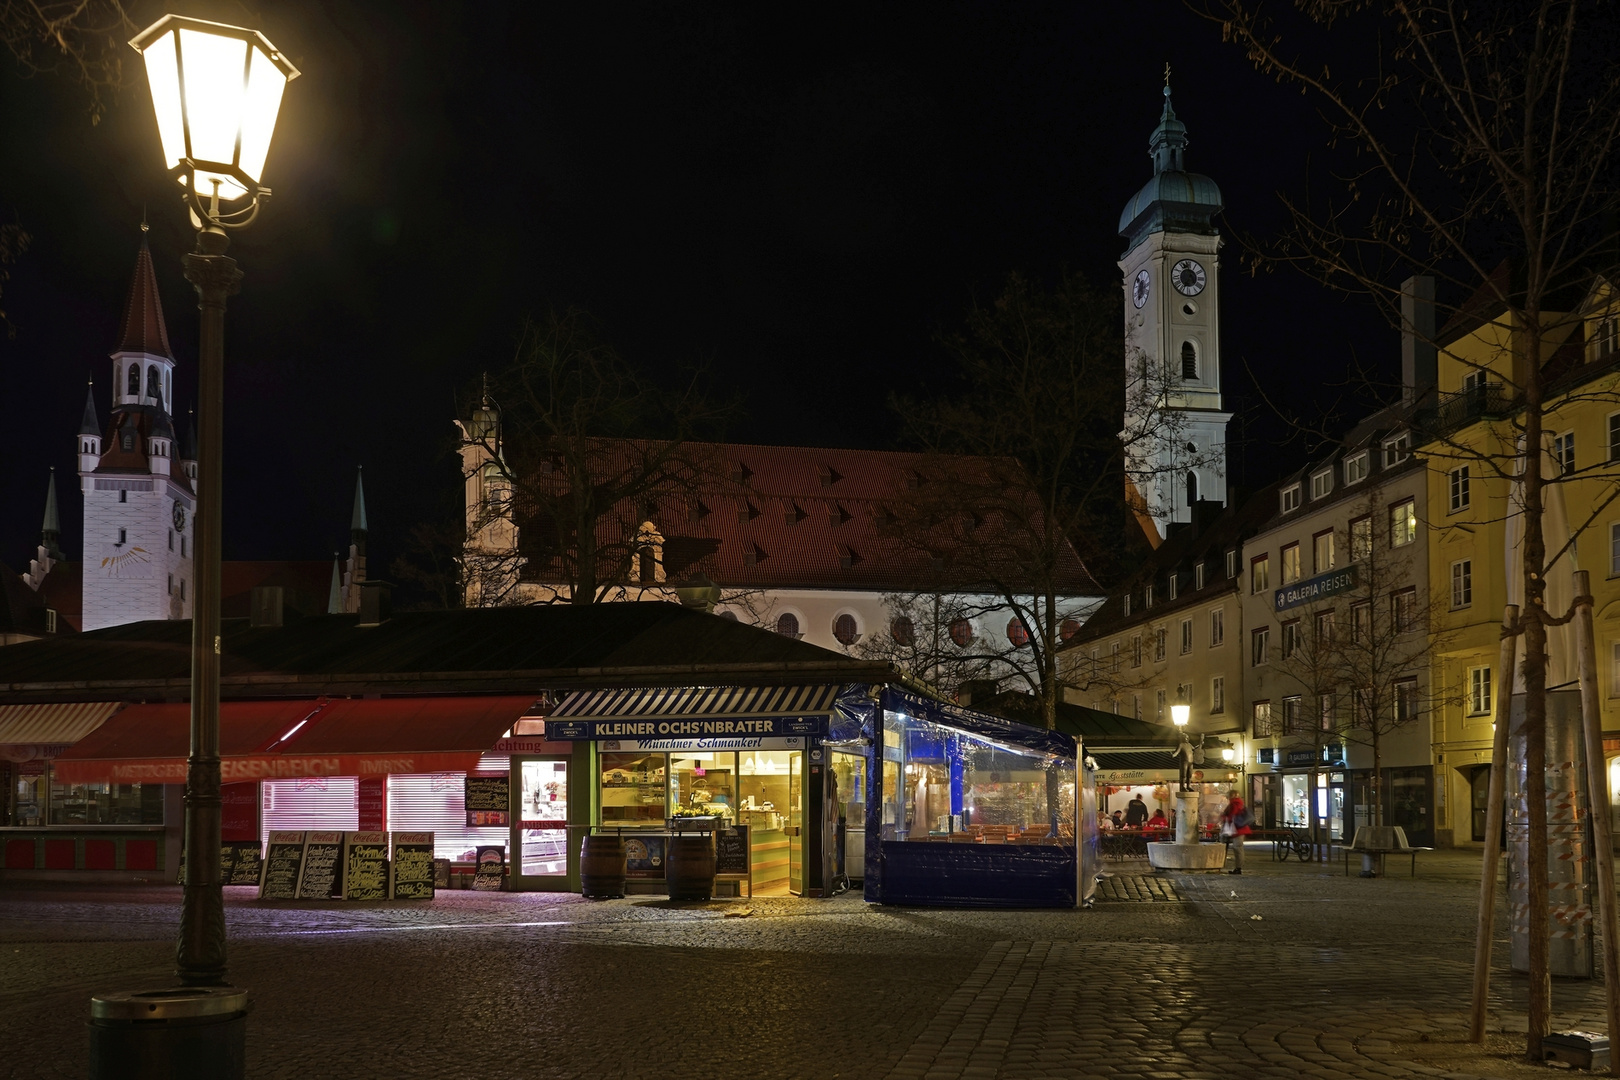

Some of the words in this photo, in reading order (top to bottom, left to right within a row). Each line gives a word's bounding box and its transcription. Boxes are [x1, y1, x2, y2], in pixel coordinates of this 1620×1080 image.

[1287, 583, 1319, 603] GALERIA
[1321, 572, 1353, 593] REISEN
[595, 722, 655, 736] KLEINER
[661, 720, 774, 735] OCHS'NBRATER
[491, 740, 541, 753] achtung
[637, 737, 693, 750] Münchner
[697, 736, 764, 749] Schmankerl
[112, 764, 186, 778] METZGER
[221, 759, 340, 777] EISENREICH
[360, 759, 415, 774] IMBISS
[1108, 771, 1145, 781] Gaststätte
[522, 821, 554, 829] IMBISS
